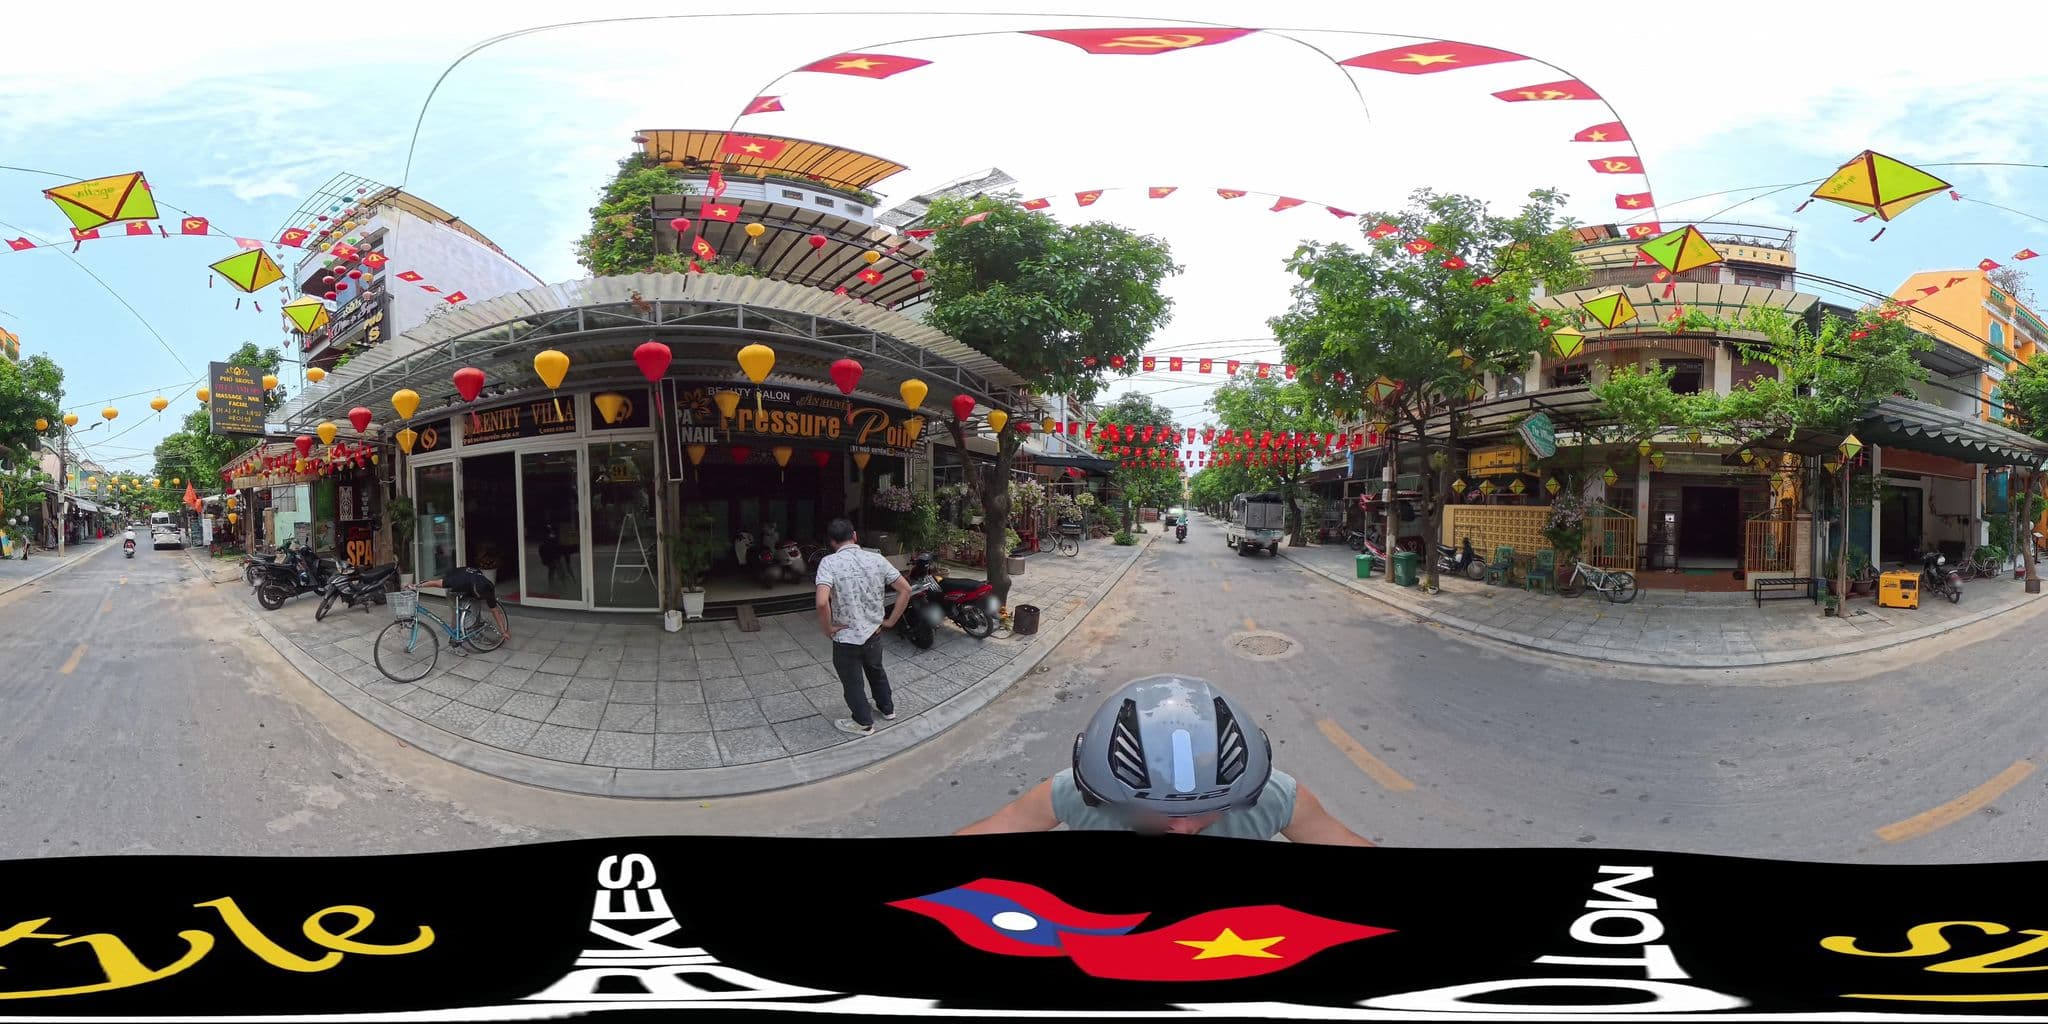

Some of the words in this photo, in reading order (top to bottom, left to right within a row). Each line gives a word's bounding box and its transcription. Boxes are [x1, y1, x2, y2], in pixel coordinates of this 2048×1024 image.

[215, 392, 242, 400] MASSAGE
[707, 386, 751, 396] BEUTY
[681, 427, 718, 443] NAIL
[844, 407, 922, 448] Poin
[347, 539, 373, 568] SPA
[1134, 787, 1231, 802] LS2
